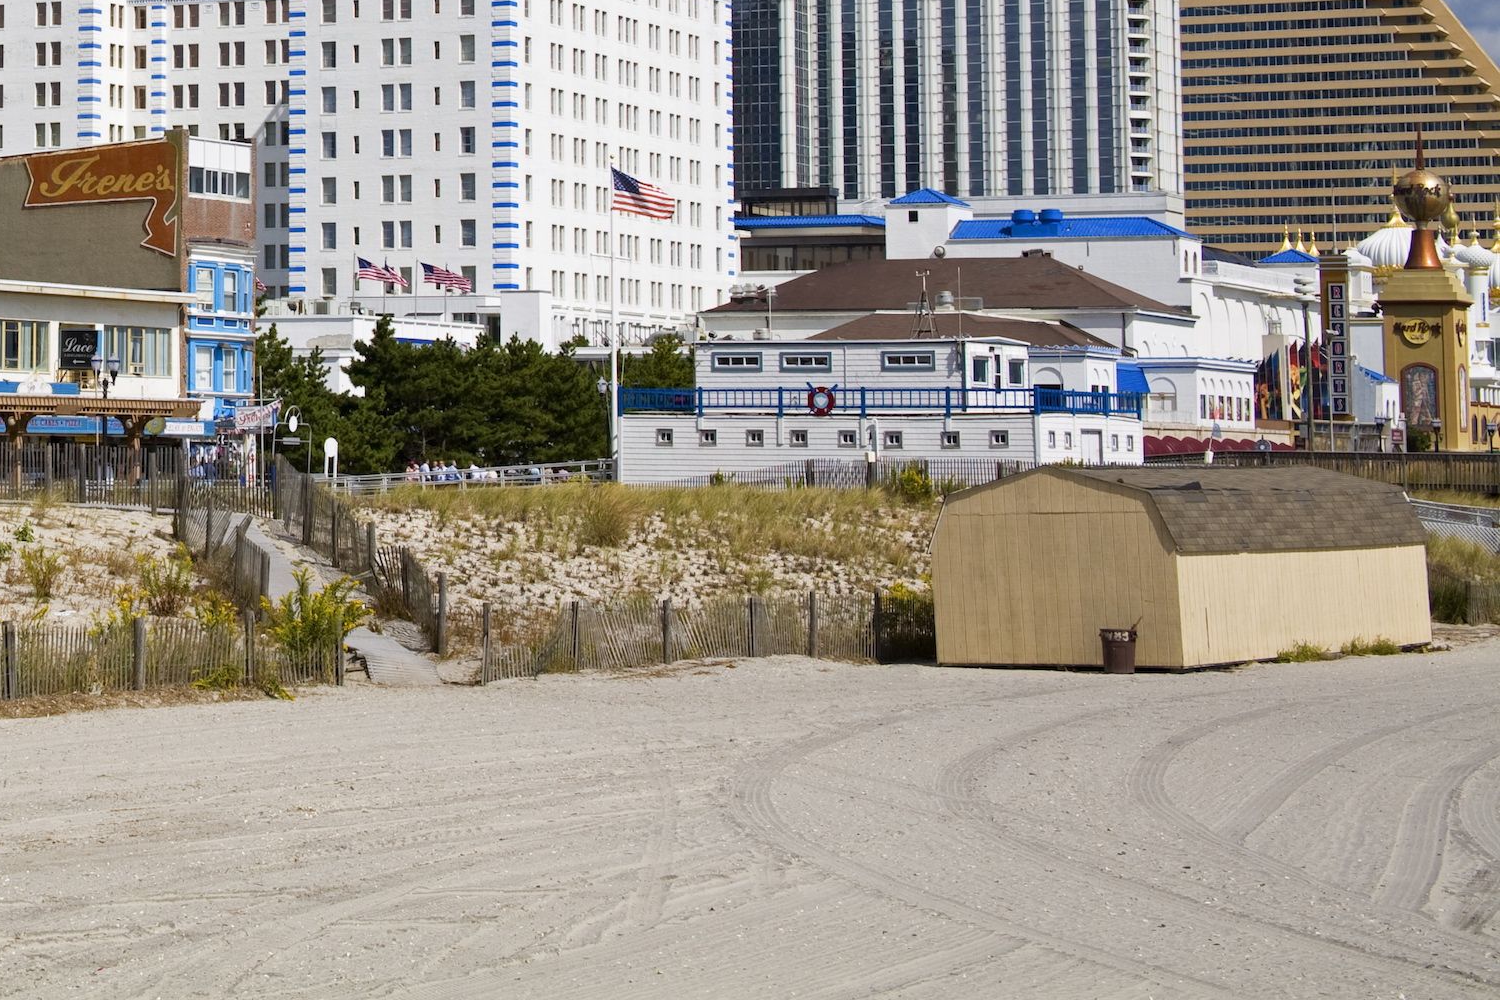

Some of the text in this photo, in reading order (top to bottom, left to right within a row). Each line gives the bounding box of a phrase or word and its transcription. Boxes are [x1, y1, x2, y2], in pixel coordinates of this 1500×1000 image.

[39, 154, 174, 197] Irene's
[63, 337, 94, 353] Lace
[1332, 284, 1346, 411] RESORTS
